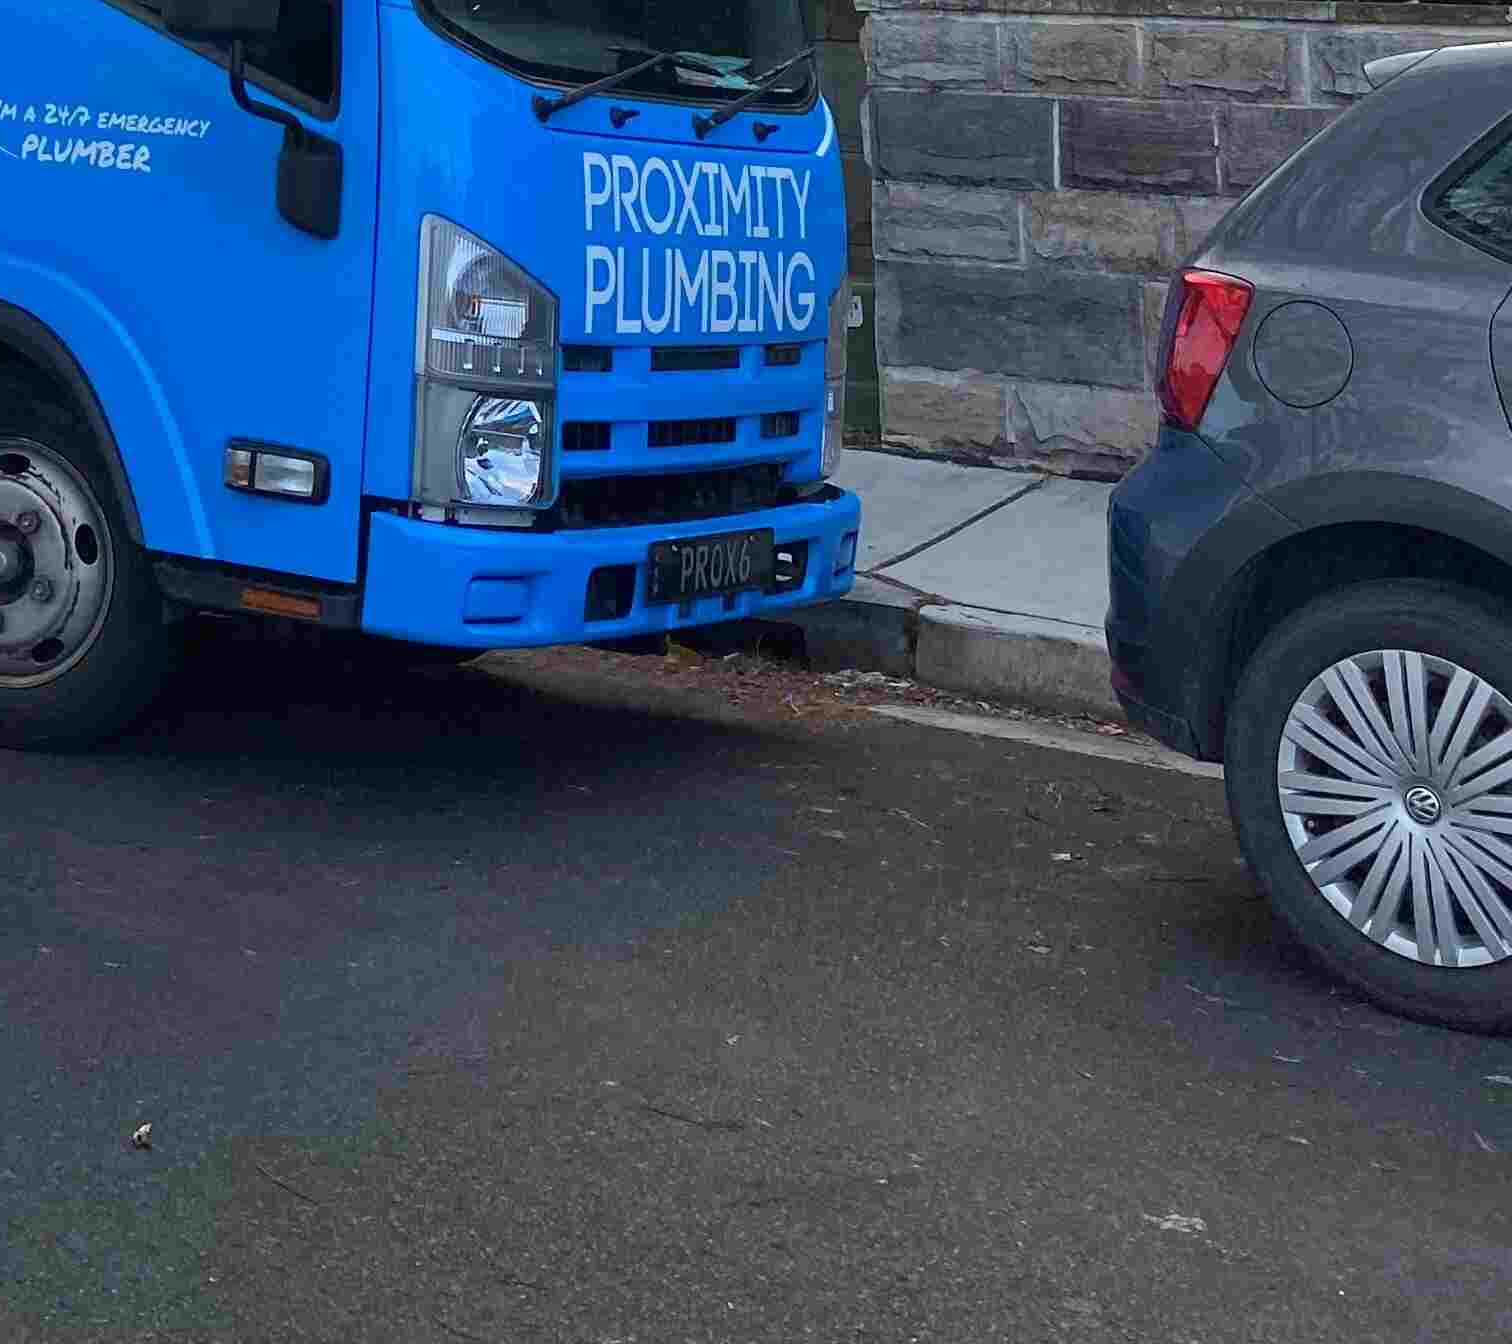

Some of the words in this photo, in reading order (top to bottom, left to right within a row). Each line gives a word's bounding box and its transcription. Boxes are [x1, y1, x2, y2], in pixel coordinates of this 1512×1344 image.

[24, 105, 36, 123] A
[44, 103, 91, 128] 24/7
[97, 111, 211, 138] EMERGENCY
[21, 134, 152, 173] PLUMBER
[583, 152, 810, 239] PROXIMITY
[584, 245, 815, 334] PLUMBING
[680, 540, 751, 593] PROX6
